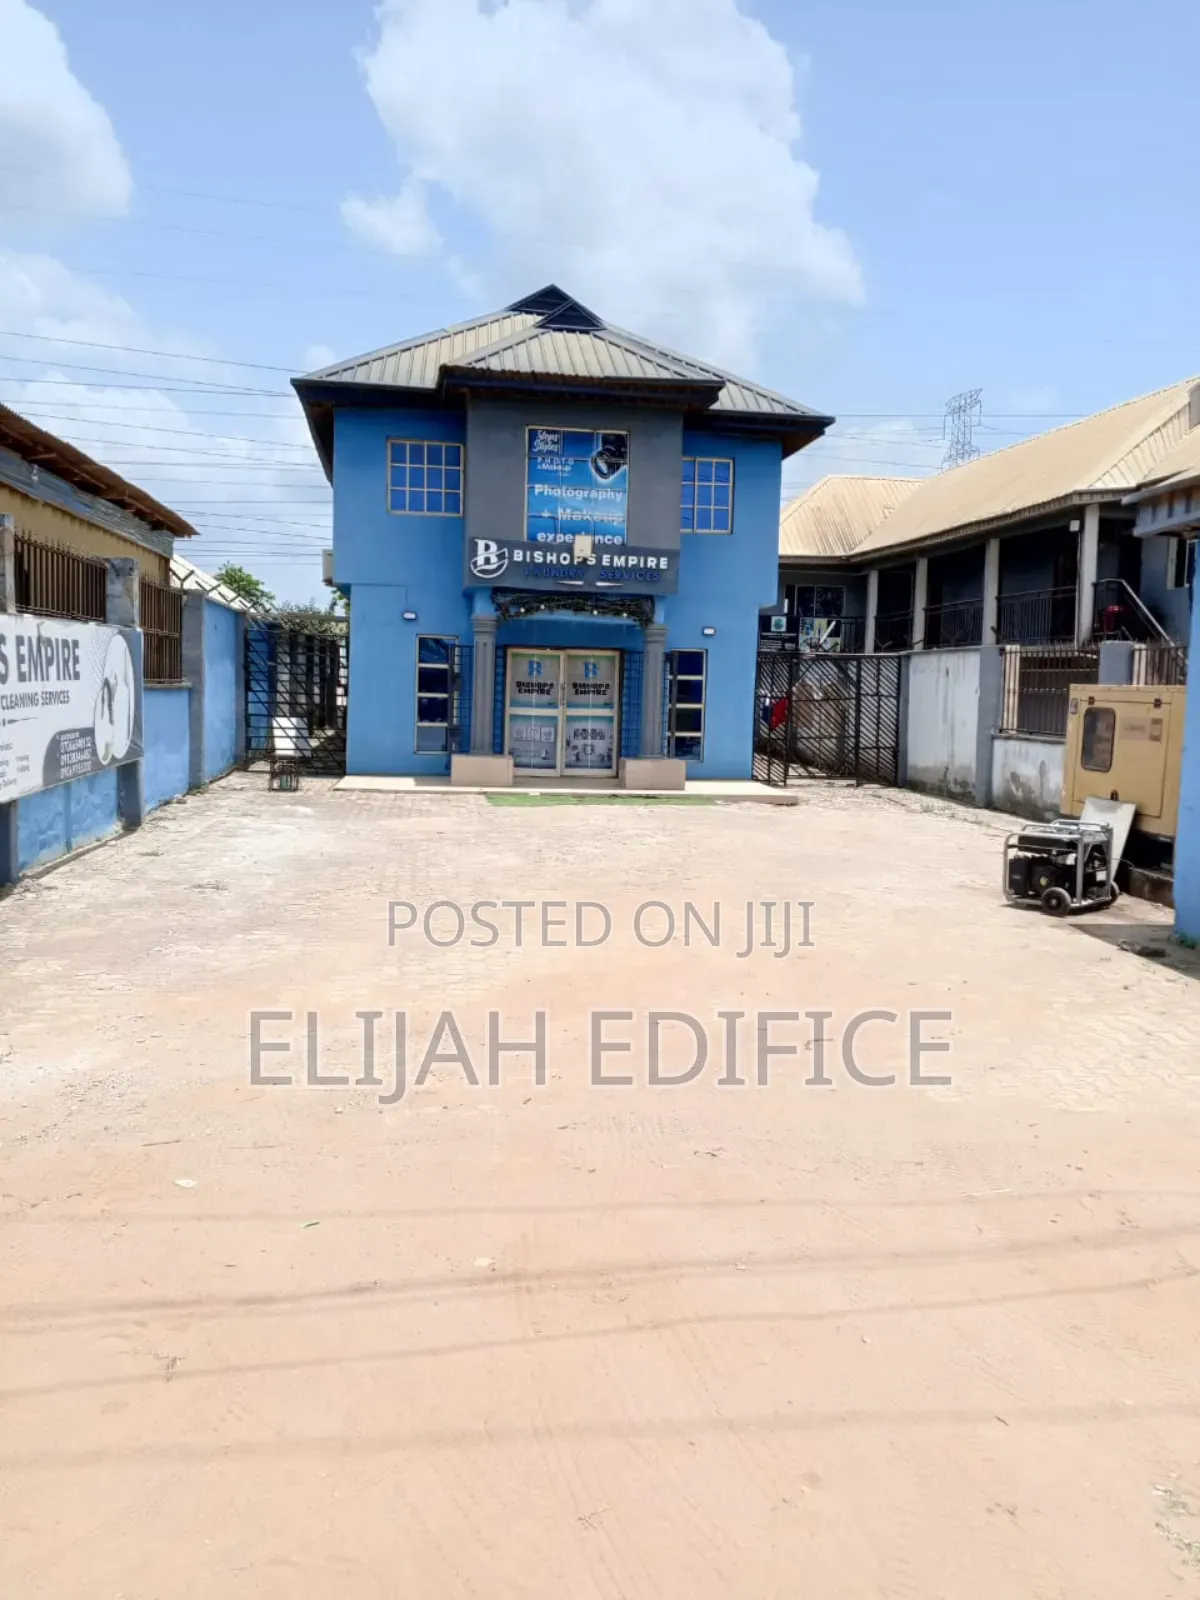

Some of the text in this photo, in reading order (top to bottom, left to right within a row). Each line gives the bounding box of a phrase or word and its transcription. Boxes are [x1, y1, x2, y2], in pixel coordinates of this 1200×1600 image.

[534, 484, 623, 503] Photography
[536, 532, 623, 545] expence
[602, 554, 669, 570] EMPIRE
[599, 568, 661, 582] SERVICES
[15, 635, 81, 683] EMPIRE
[0, 690, 70, 711] CLEANING SERVICES
